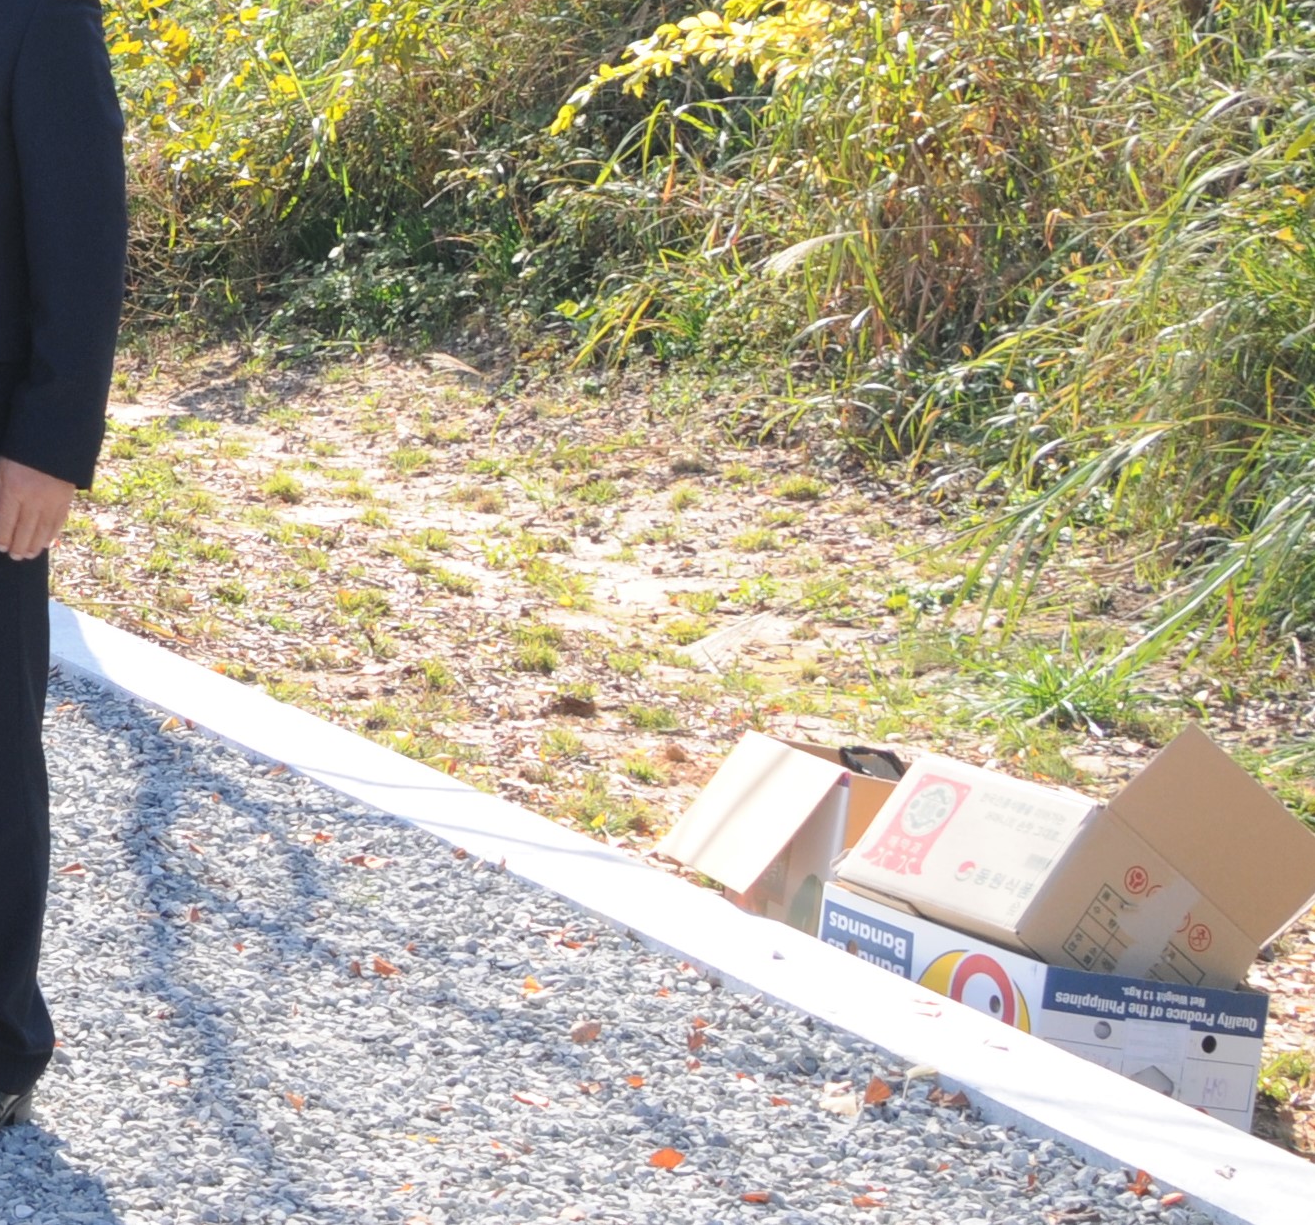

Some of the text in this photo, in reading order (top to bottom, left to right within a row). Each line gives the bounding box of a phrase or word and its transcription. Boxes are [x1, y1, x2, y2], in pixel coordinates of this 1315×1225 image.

[828, 910, 907, 960] Bananas
[1055, 992, 1258, 1032] Quality Produce of the Philippines
[1121, 986, 1206, 1008] Net Weight 13 kgs.
